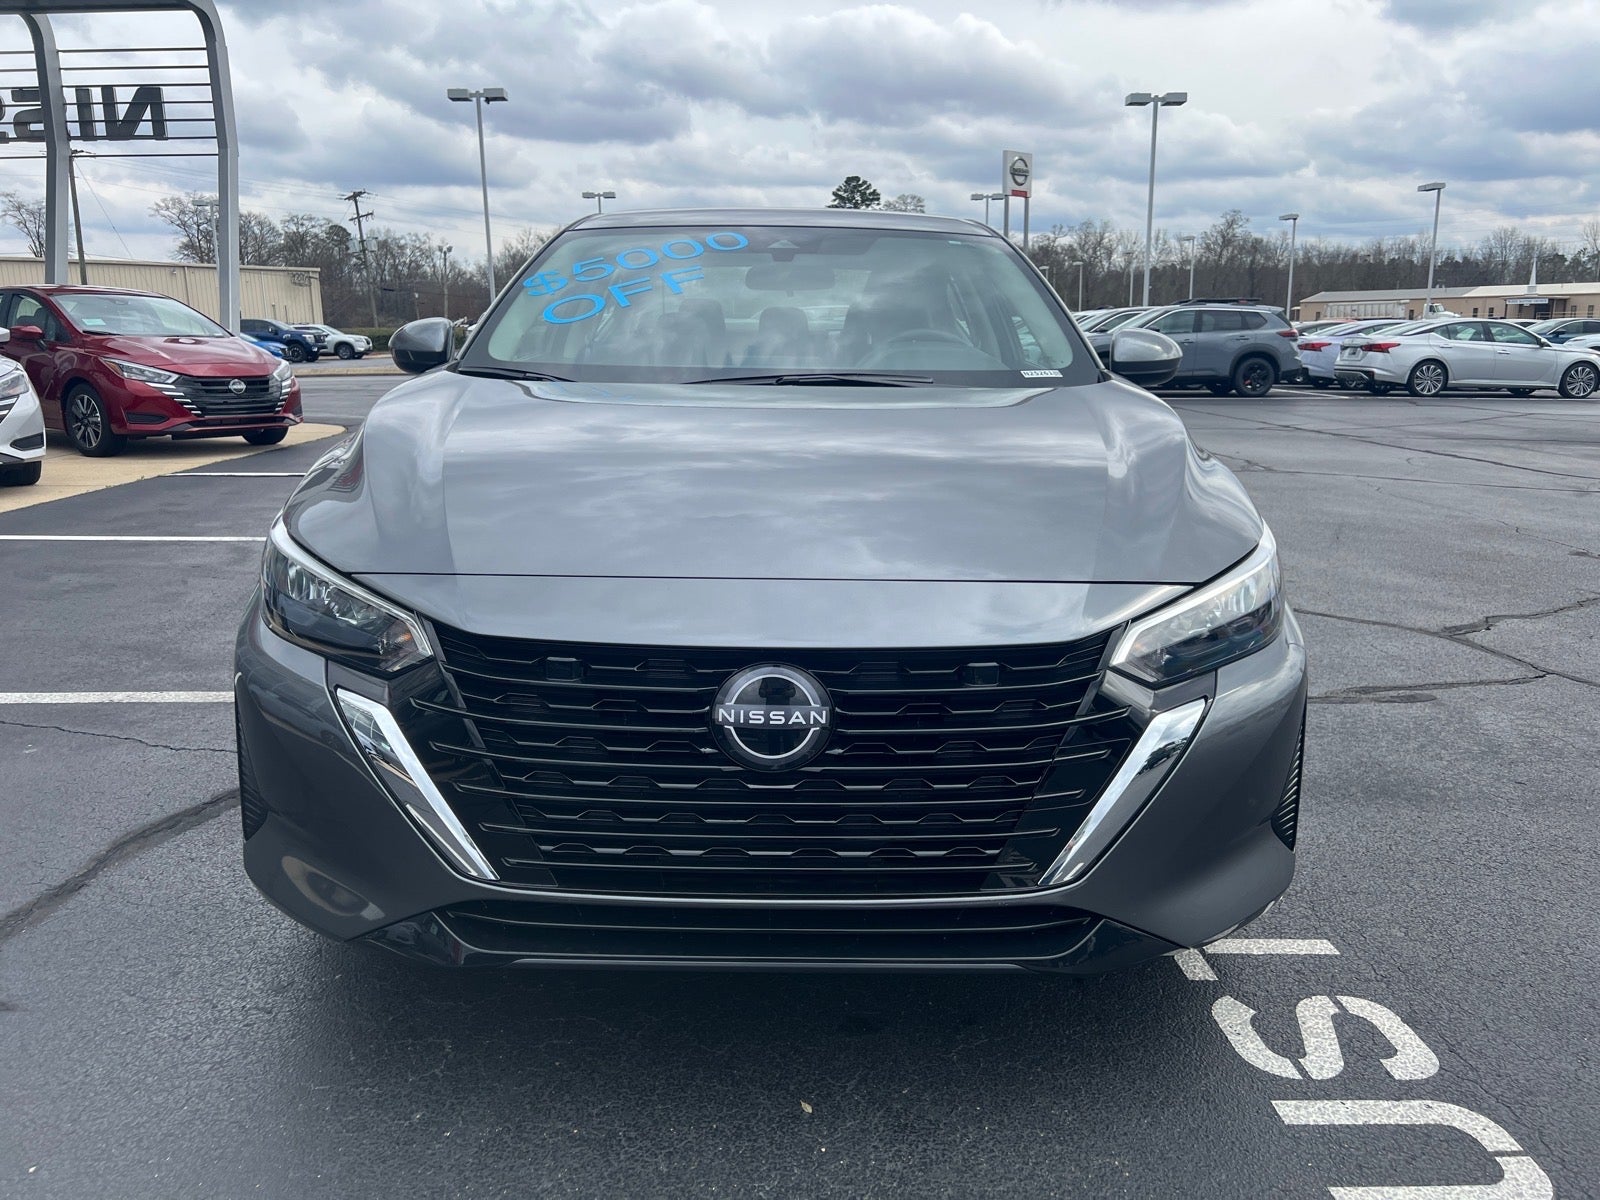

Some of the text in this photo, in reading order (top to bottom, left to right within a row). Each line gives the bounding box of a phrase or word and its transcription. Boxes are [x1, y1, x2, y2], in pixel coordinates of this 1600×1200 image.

[523, 232, 749, 296] $5000
[542, 265, 705, 324] OFF
[718, 708, 827, 725] NISSAN
